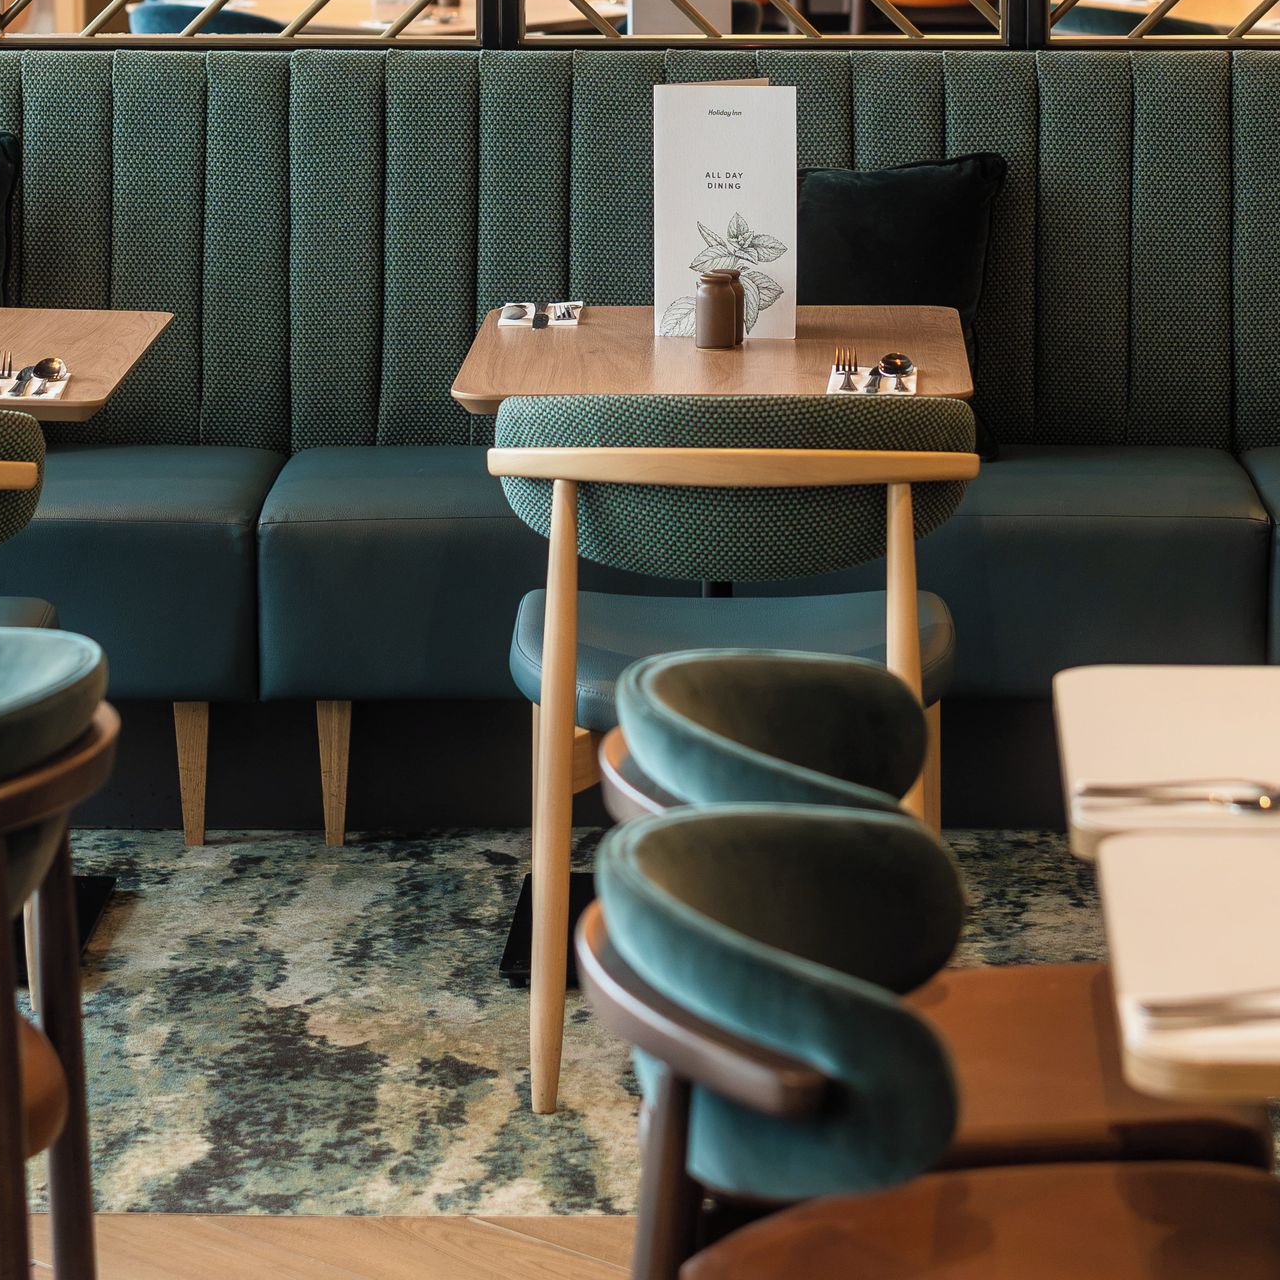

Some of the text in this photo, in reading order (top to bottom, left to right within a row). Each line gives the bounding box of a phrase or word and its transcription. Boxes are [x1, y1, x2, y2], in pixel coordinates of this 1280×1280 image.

[707, 108, 743, 118] Holiday Inn
[705, 171, 744, 179] ALL DAY
[707, 182, 742, 190] DINING
